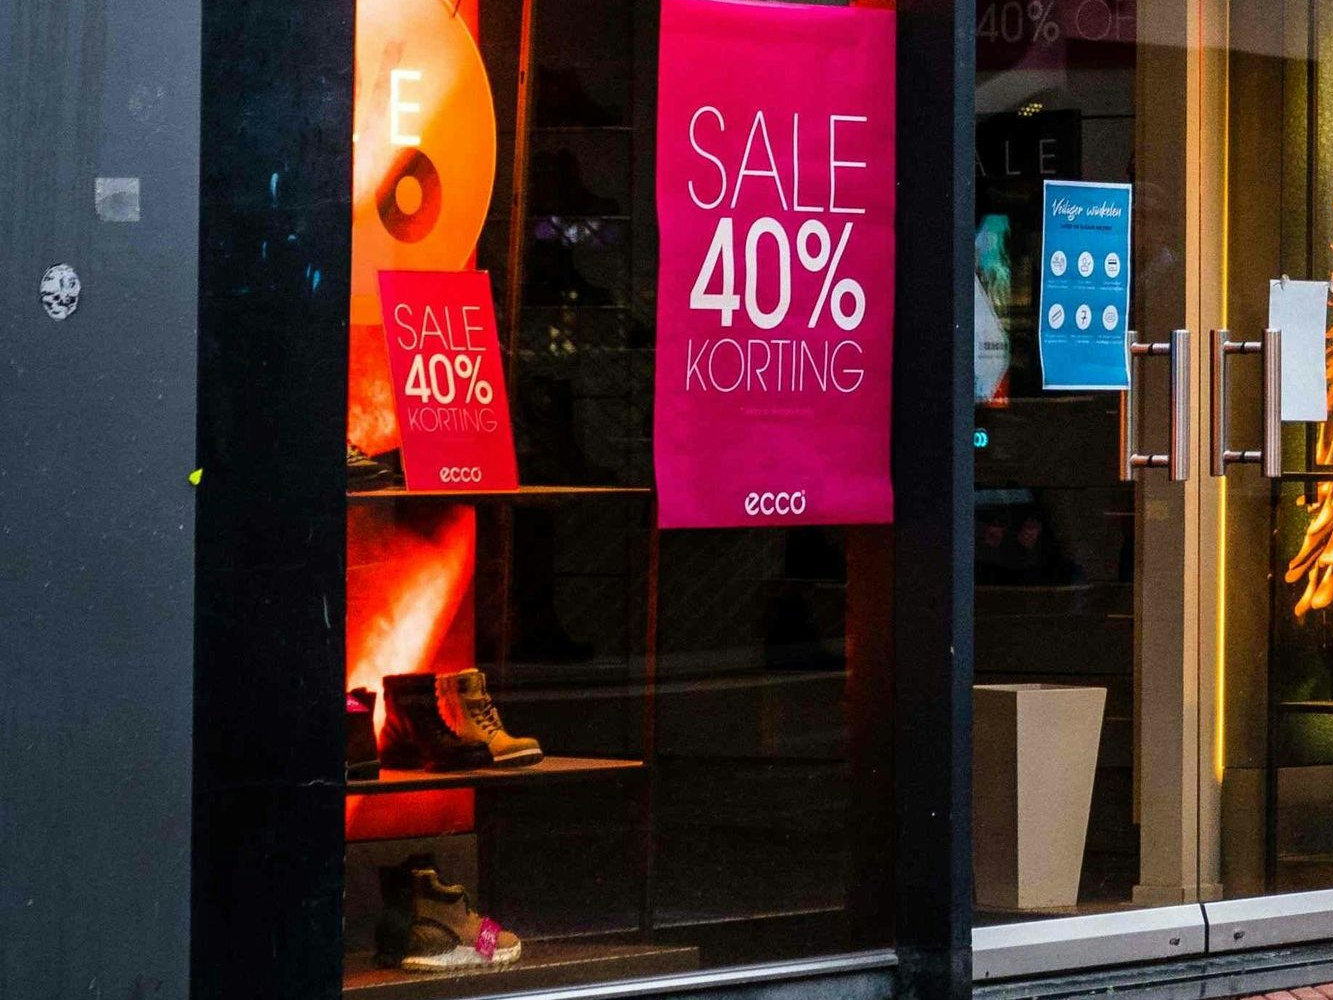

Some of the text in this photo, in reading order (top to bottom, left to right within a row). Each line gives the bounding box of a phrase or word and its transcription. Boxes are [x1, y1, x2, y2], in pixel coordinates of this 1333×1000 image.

[688, 106, 867, 215] SALE
[690, 217, 867, 331] 40%
[395, 303, 487, 353] SALE
[404, 353, 493, 405] 40%
[687, 338, 865, 395] KORTING
[408, 406, 498, 434] KORTING
[438, 465, 482, 484] ecco
[744, 490, 807, 516] ecco
